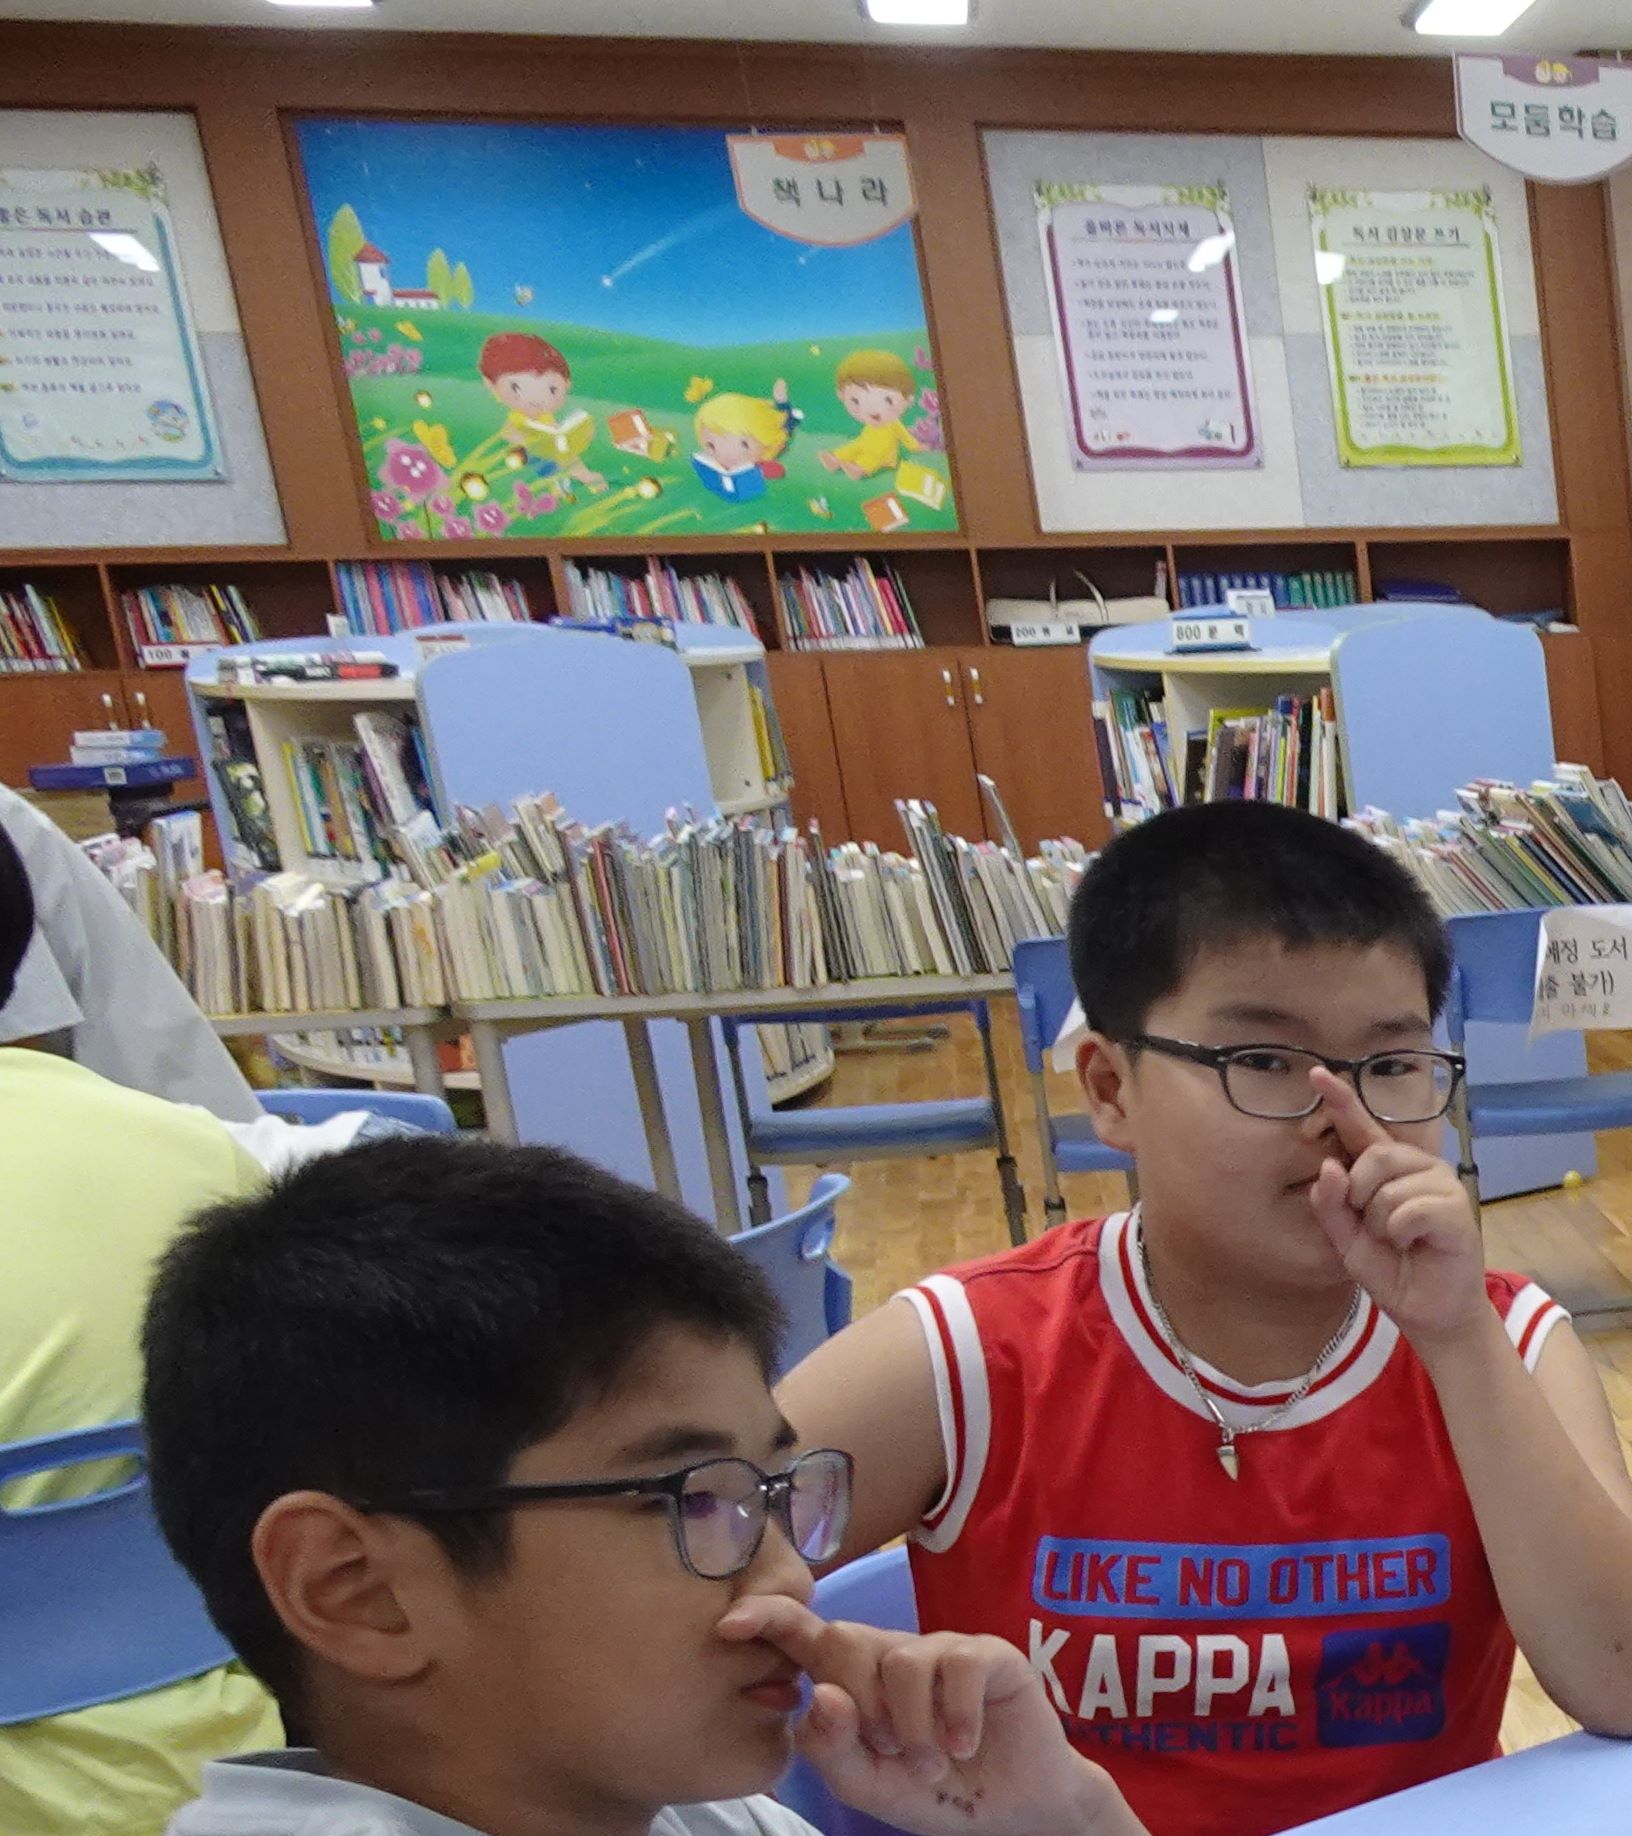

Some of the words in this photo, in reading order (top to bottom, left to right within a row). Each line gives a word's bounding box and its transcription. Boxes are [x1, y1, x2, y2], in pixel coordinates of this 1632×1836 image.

[1490, 100, 1618, 141] 모둠학습
[1176, 625, 1201, 641] 800
[1590, 936, 1628, 961] 도서
[1041, 1551, 1162, 1602] LIKE
[1177, 1557, 1250, 1606] NO
[1268, 1546, 1438, 1605] OTHER
[1029, 1617, 1297, 1720] KAPPA
[1329, 1688, 1434, 1724] Kappa
